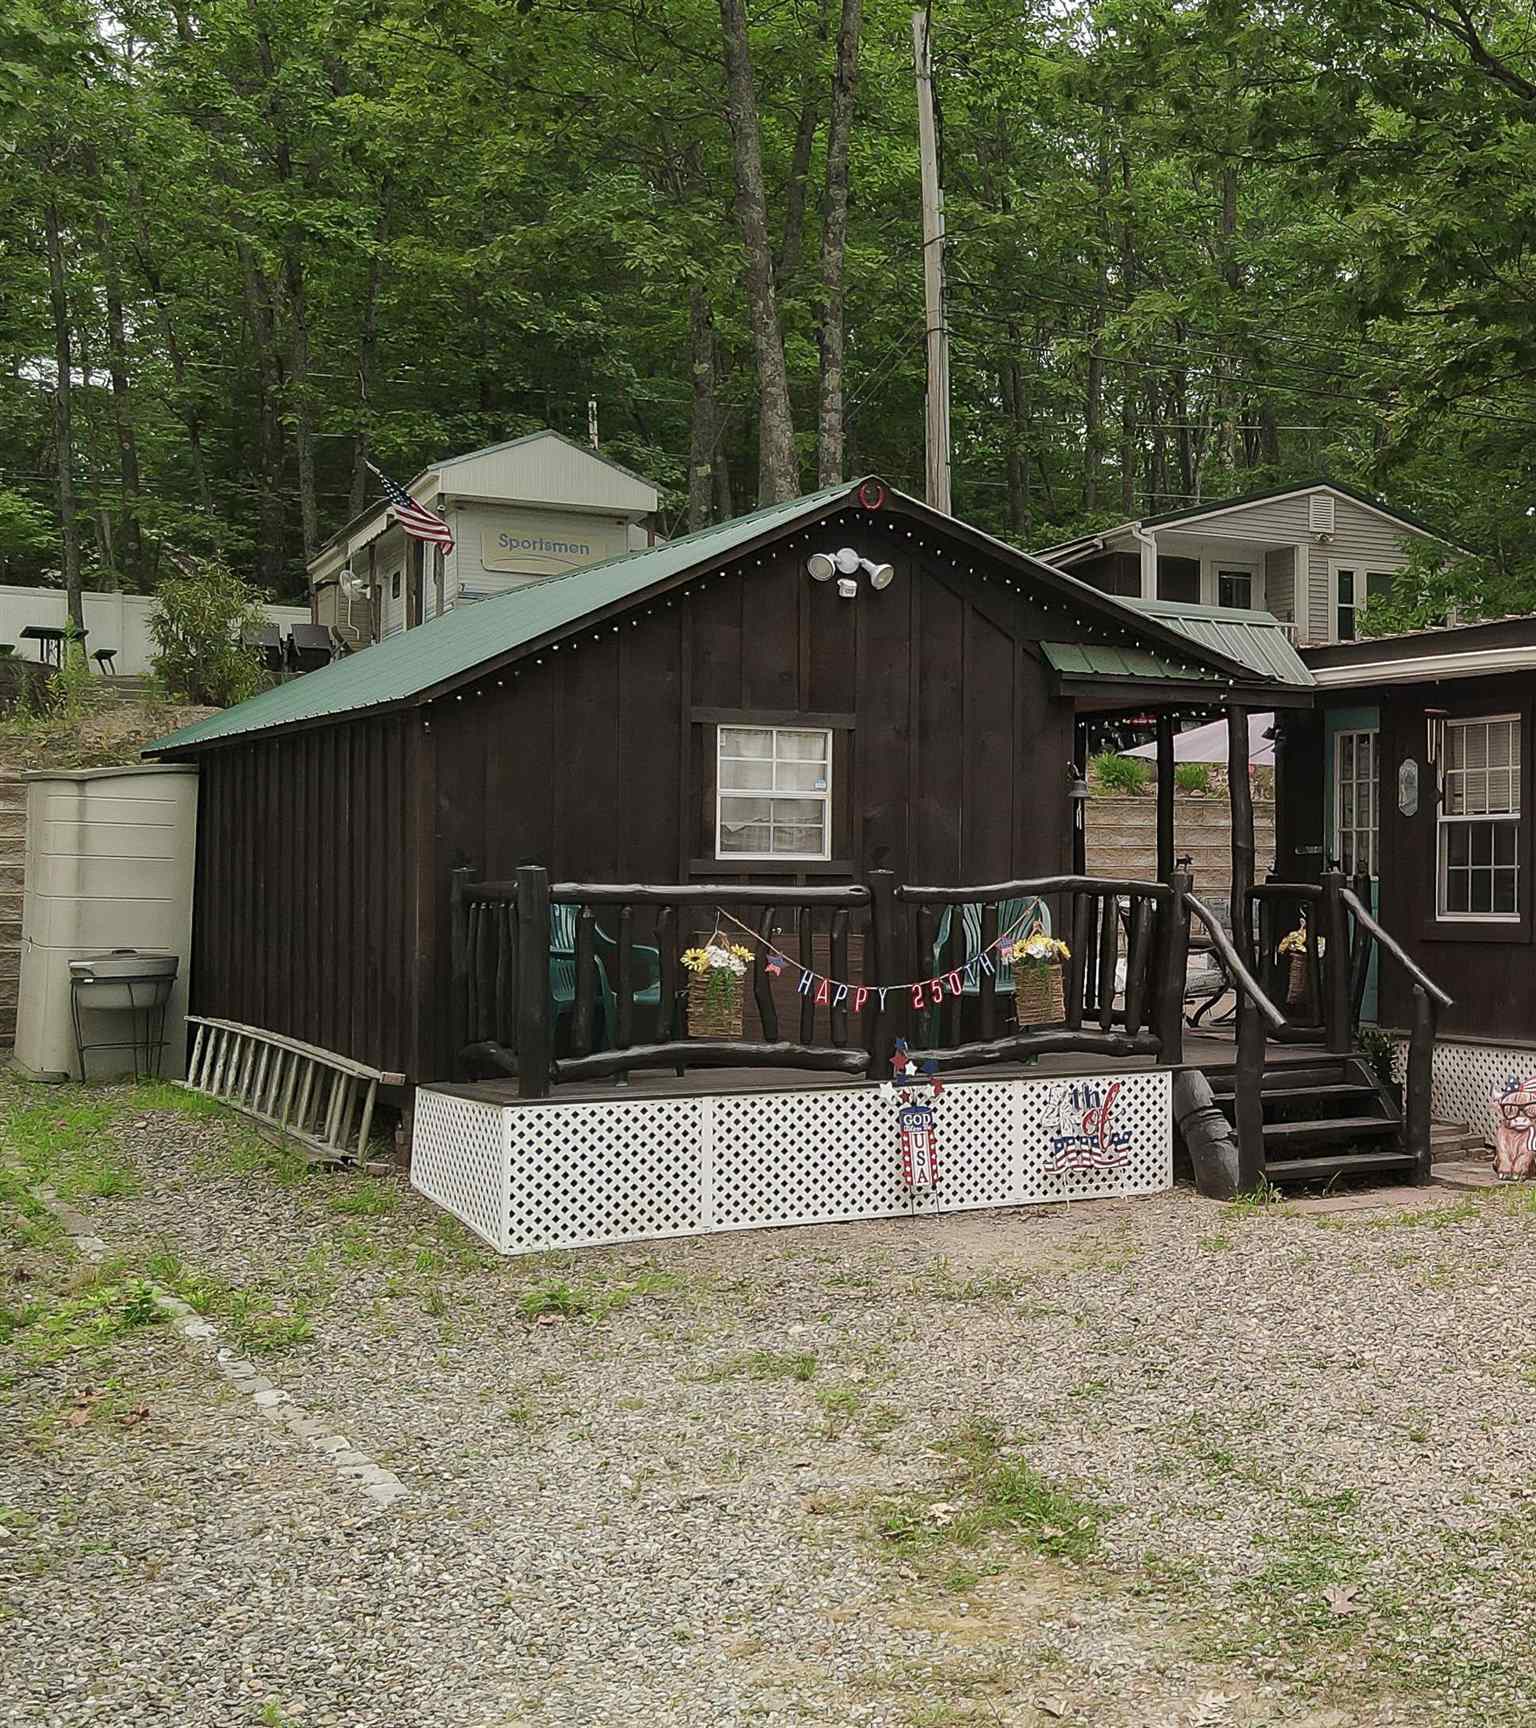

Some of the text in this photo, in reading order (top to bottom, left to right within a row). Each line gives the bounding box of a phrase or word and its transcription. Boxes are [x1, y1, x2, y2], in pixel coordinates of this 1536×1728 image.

[797, 952, 996, 1012] HAPPY 250TH
[903, 1113, 932, 1126] GOD
[912, 1132, 929, 1184] USA
